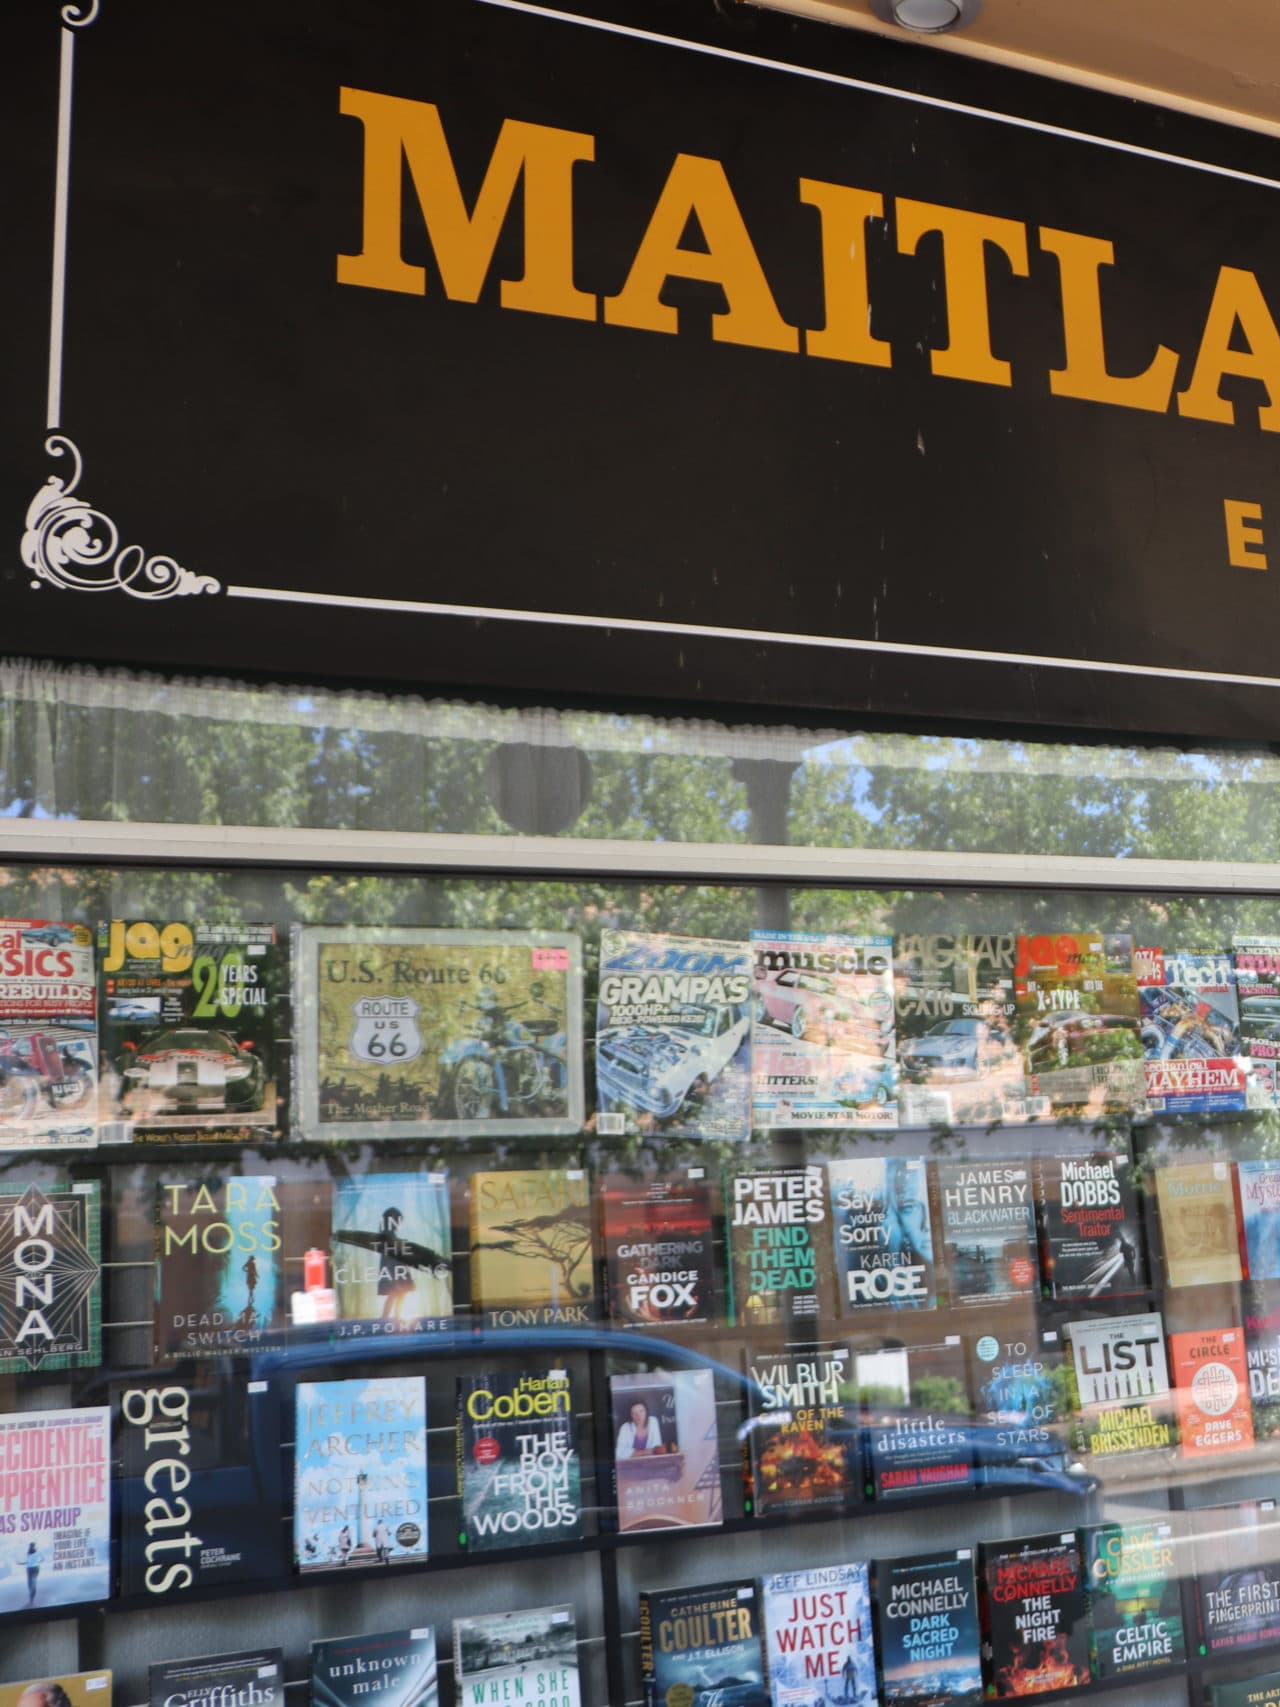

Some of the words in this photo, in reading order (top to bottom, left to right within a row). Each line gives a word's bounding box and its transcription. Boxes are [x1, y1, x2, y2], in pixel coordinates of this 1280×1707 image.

[103, 919, 193, 972] jag
[326, 959, 383, 984] U.S.
[392, 960, 470, 984] Route
[479, 962, 506, 984] 66
[755, 946, 889, 976] muscle
[221, 964, 258, 983] YEARS
[220, 987, 267, 1005] SPECIAL
[600, 977, 749, 1006] GRAMPA'S
[361, 1001, 408, 1016] ROUTE
[367, 1033, 407, 1057] 66
[1145, 1070, 1240, 1090] MAYHEM
[327, 1102, 350, 1115] The
[353, 1103, 397, 1114] Mother
[956, 1170, 1014, 1186] JAMES
[1061, 1159, 1115, 1181] Michael
[164, 1183, 280, 1215] TARA
[733, 1174, 824, 1201] PETER
[945, 1184, 1027, 1207] HENRY
[1060, 1179, 1120, 1207] DOBBS
[837, 1189, 874, 1212] Say
[732, 1199, 825, 1226] JAMES
[948, 1206, 1031, 1225] BLACKWATER
[1061, 1205, 1125, 1225] Sentimental
[165, 1221, 281, 1255] MOSS
[753, 1226, 809, 1248] FIND
[839, 1224, 891, 1245] Sorry
[1077, 1220, 1112, 1238] Traitor
[370, 1240, 414, 1255] THE
[617, 1241, 703, 1258] GATHERING
[747, 1249, 816, 1269] THEM
[860, 1251, 911, 1268] KAREN
[14, 1204, 54, 1342] MONA
[627, 1269, 698, 1286] CANDICE
[752, 1268, 816, 1292] DEAD
[847, 1265, 928, 1301] ROSE
[629, 1283, 697, 1309] FOX
[173, 1312, 223, 1328] DEAD
[489, 1309, 540, 1328] TONY
[544, 1306, 589, 1323] PARK
[187, 1329, 261, 1345] SWITCH
[1005, 1342, 1027, 1356] TO
[1080, 1337, 1159, 1375] LIST
[1190, 1344, 1230, 1359] CIRCLE
[520, 1377, 570, 1393] Harlan
[750, 1361, 845, 1390] WILBUR
[468, 1389, 571, 1420] Coben
[761, 1381, 839, 1408] SMITH
[306, 1399, 417, 1432] JEFFREY
[796, 1410, 815, 1420] OF
[819, 1407, 844, 1419] THE
[896, 1415, 945, 1435] little
[1099, 1406, 1153, 1429] MICHAEL
[781, 1420, 824, 1433] RAVEN
[996, 1429, 1049, 1446] STARS
[1204, 1420, 1232, 1432] DAVE
[306, 1432, 421, 1459] ARCHER
[516, 1432, 567, 1453] THE
[878, 1431, 966, 1451] disasters
[1090, 1424, 1169, 1454] BRISSENDEN
[1195, 1430, 1242, 1447] EGGERS
[520, 1450, 574, 1474] BOY
[122, 1386, 203, 1593] greats
[493, 1470, 569, 1496] FROM
[881, 1468, 916, 1488] SARAH
[521, 1488, 570, 1511] THE
[20, 1507, 81, 1532] SWARUP
[304, 1500, 421, 1525] VENTURED
[473, 1505, 578, 1536] WOODS
[997, 1558, 1071, 1582] MICHAEL
[1092, 1548, 1174, 1578] CUSSLER
[769, 1575, 801, 1591] JEFF
[806, 1566, 863, 1587] LINDSAY
[891, 1576, 964, 1600] MICHAEL
[992, 1575, 1078, 1602] CONNELLY
[886, 1592, 970, 1619] CONNELLY
[1022, 1596, 1051, 1612] THE
[1206, 1590, 1232, 1609] THE
[1239, 1581, 1280, 1603] FIRST
[670, 1598, 738, 1618] CATHERINE
[787, 1591, 848, 1623] JUST
[1209, 1599, 1280, 1624] FINGERPRINT
[659, 1607, 753, 1653] COULTER
[910, 1613, 950, 1632] DARK
[1015, 1609, 1061, 1629] NIGHT
[776, 1619, 863, 1654] WATCH
[903, 1627, 959, 1648] SACRED
[1023, 1626, 1056, 1644] FIRE
[1115, 1622, 1168, 1647] CELTIC
[705, 1644, 745, 1658] ELLISON
[910, 1643, 953, 1663] NIGHT
[1113, 1638, 1173, 1664] EMPIRE
[329, 1653, 424, 1677] unknown
[804, 1651, 841, 1680] ME
[352, 1673, 401, 1695] male
[472, 1679, 524, 1704] WHEN
[537, 1669, 569, 1693] SHE
[1248, 1693, 1268, 1702] THE
